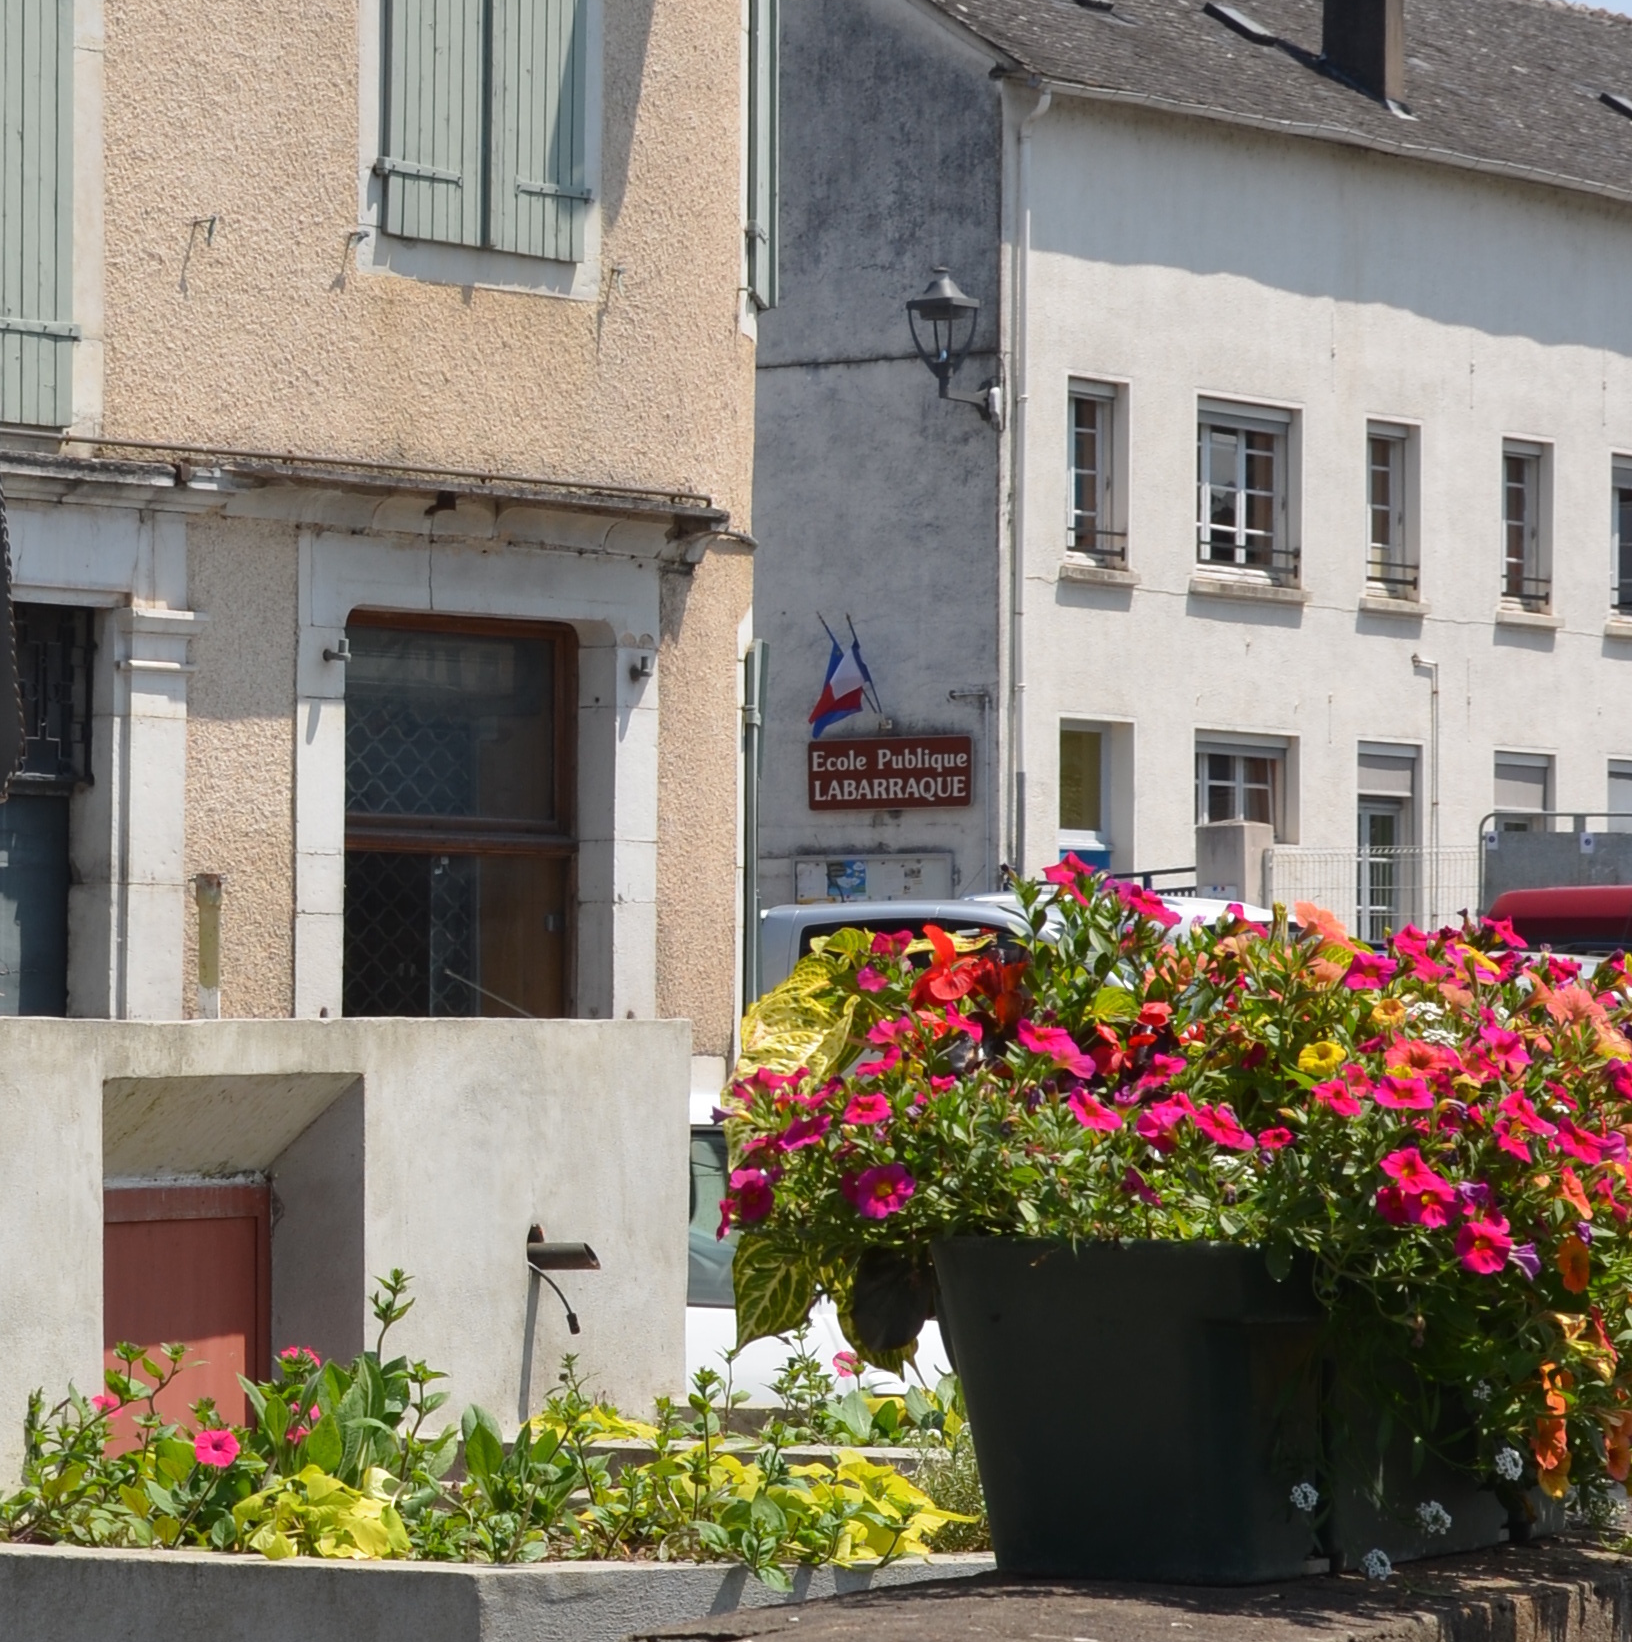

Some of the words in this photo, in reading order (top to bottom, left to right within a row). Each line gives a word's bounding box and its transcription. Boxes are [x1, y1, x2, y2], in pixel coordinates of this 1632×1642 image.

[812, 749, 867, 772] Ecole
[877, 747, 968, 773] Publique
[814, 776, 967, 802] LABARRAQUE
